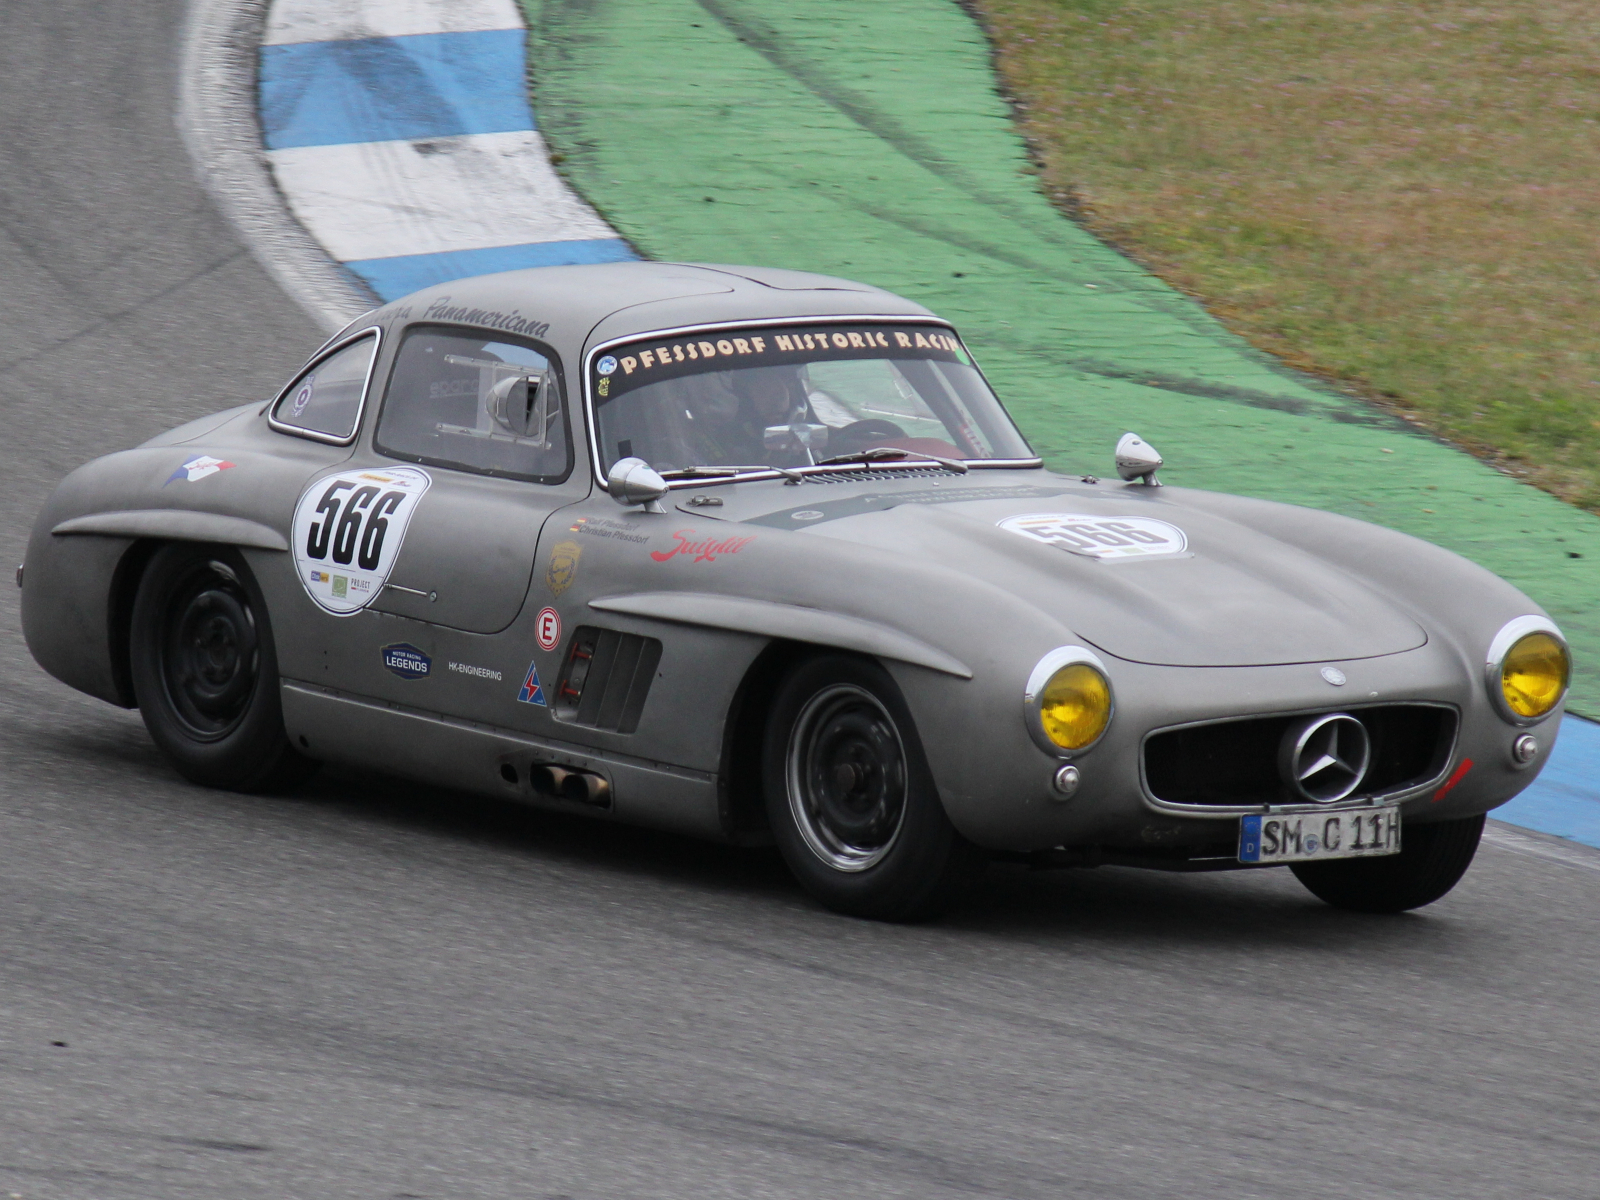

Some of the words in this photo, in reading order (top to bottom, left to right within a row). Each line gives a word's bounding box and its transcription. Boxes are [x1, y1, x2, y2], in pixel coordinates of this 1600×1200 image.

[422, 296, 551, 339] Panamericana
[619, 336, 767, 374] PFESSDORF
[774, 331, 889, 351] HISTORIC
[893, 331, 963, 352] RACIN
[307, 479, 407, 571] 566
[579, 524, 612, 538] Christian
[612, 530, 650, 545] Pfessdorf
[1021, 521, 1170, 551] 566
[350, 577, 371, 589] PROJECT
[543, 617, 553, 641] E
[386, 656, 428, 673] LEGENDS
[448, 661, 502, 681] HK-ENGINEERING
[1246, 843, 1255, 853] D
[1261, 819, 1302, 855] SM
[1348, 811, 1400, 850] 11H
